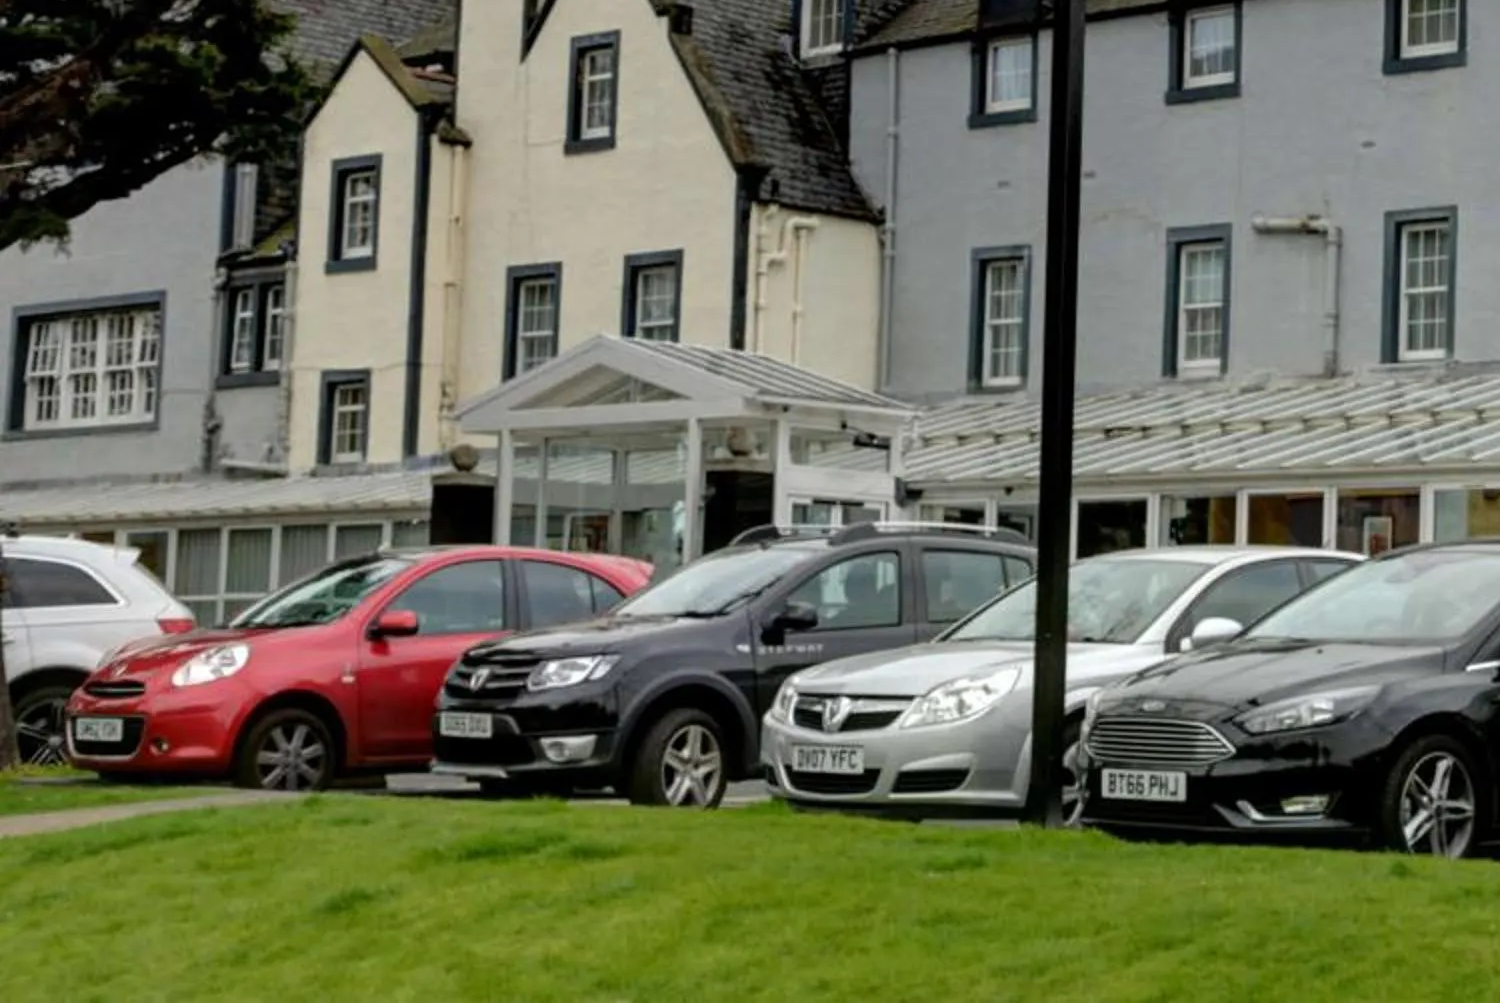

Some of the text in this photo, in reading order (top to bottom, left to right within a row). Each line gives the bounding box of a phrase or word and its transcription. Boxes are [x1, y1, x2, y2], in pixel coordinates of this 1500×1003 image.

[830, 748, 858, 770] YFC
[1107, 772, 1179, 797] BT66 PHJ
